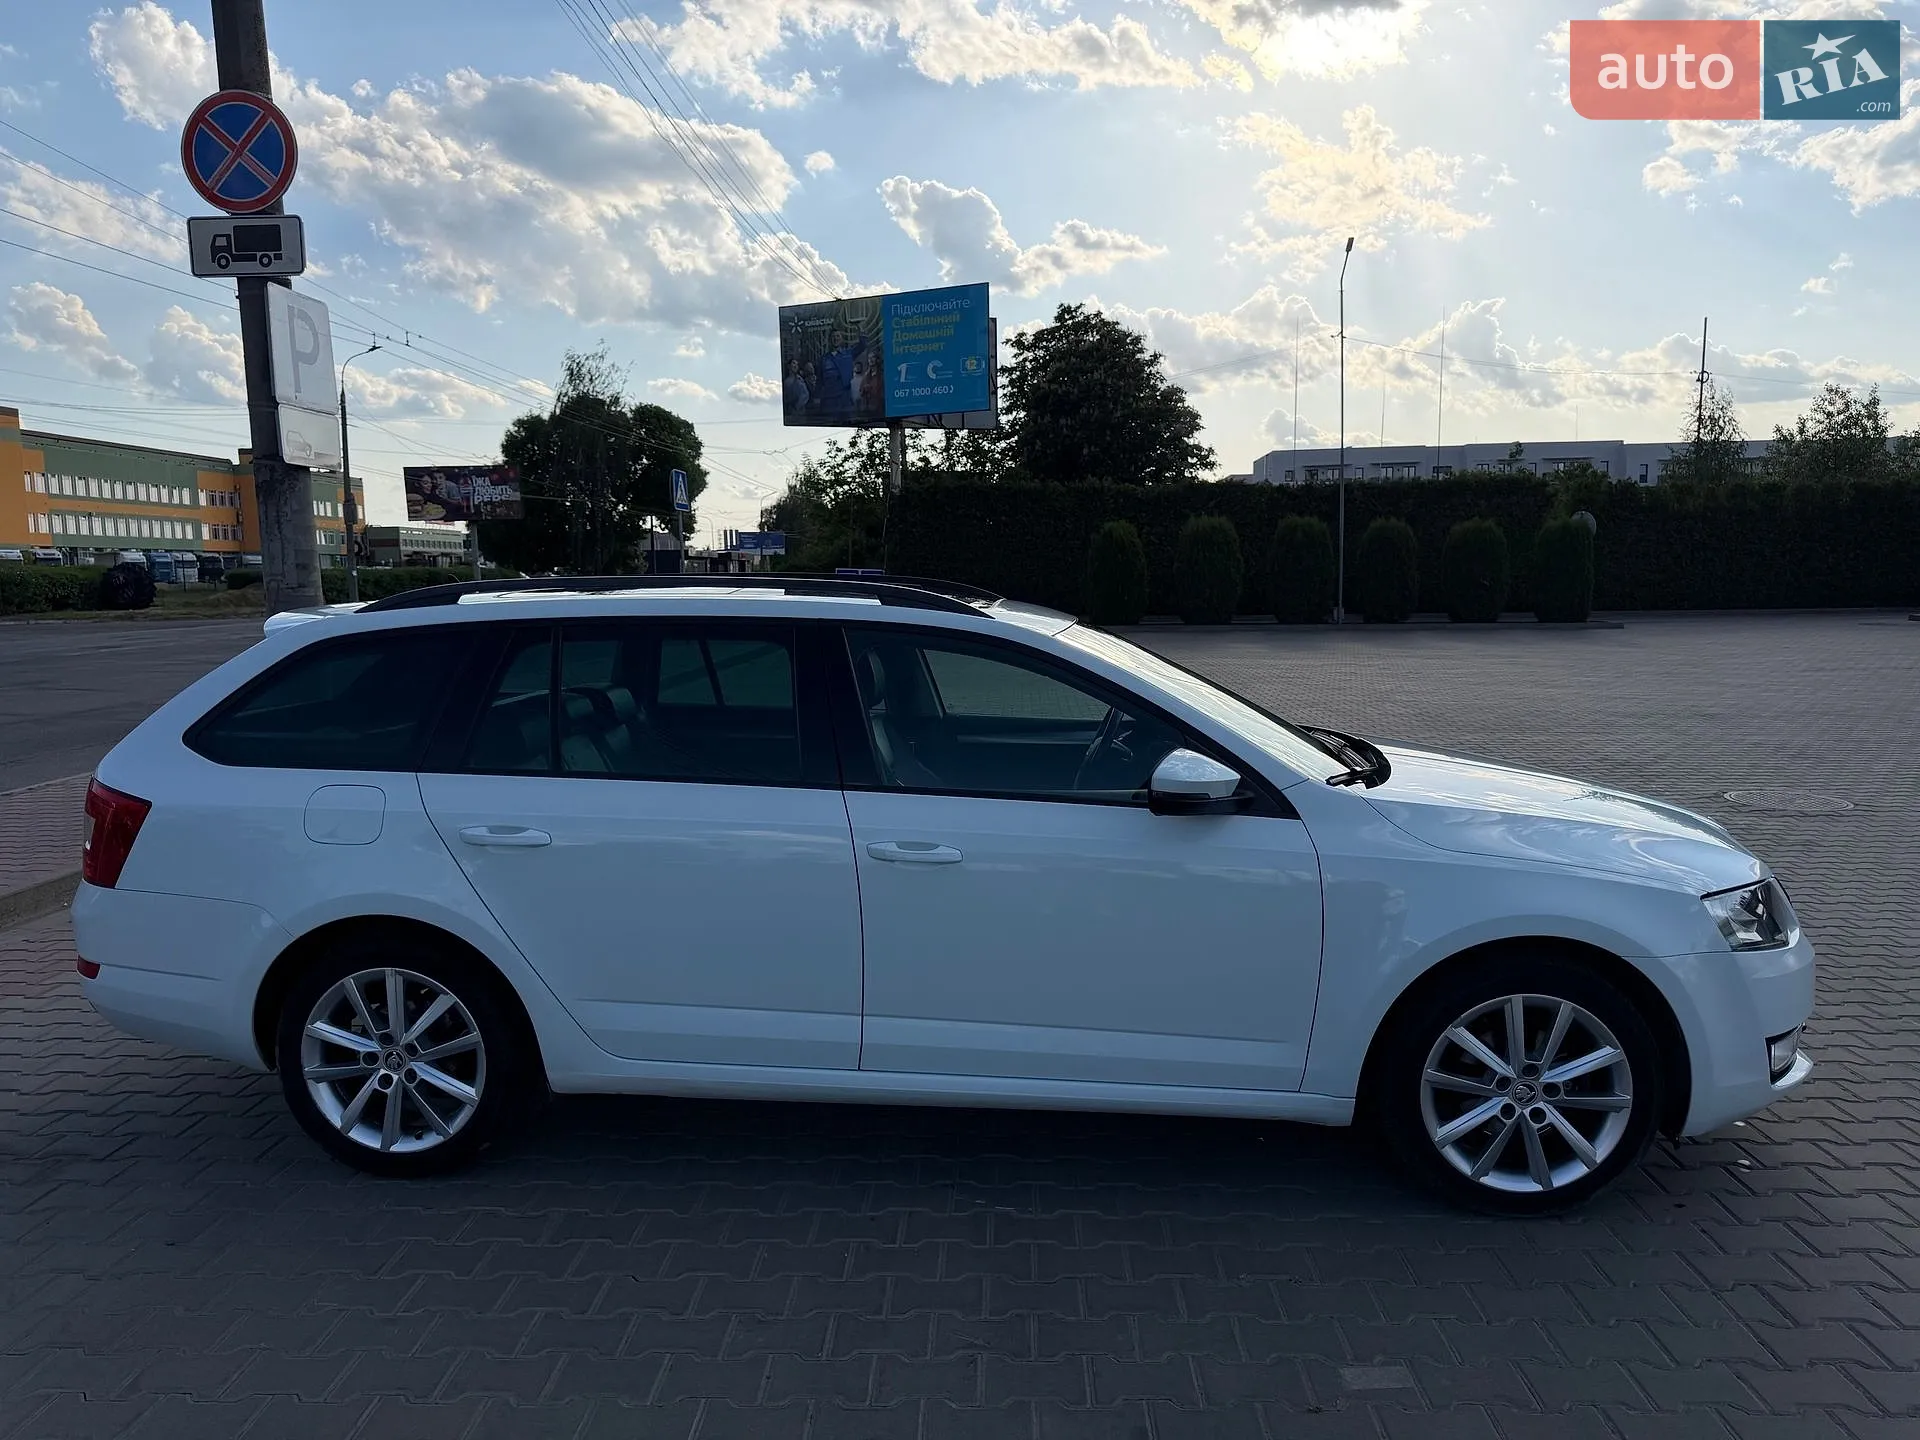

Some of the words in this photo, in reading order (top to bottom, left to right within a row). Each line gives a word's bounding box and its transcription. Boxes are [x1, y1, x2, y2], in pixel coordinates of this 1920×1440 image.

[891, 298, 970, 316] Підключайте
[287, 304, 320, 394] P
[894, 388, 910, 398] 067
[912, 387, 931, 397] 1000
